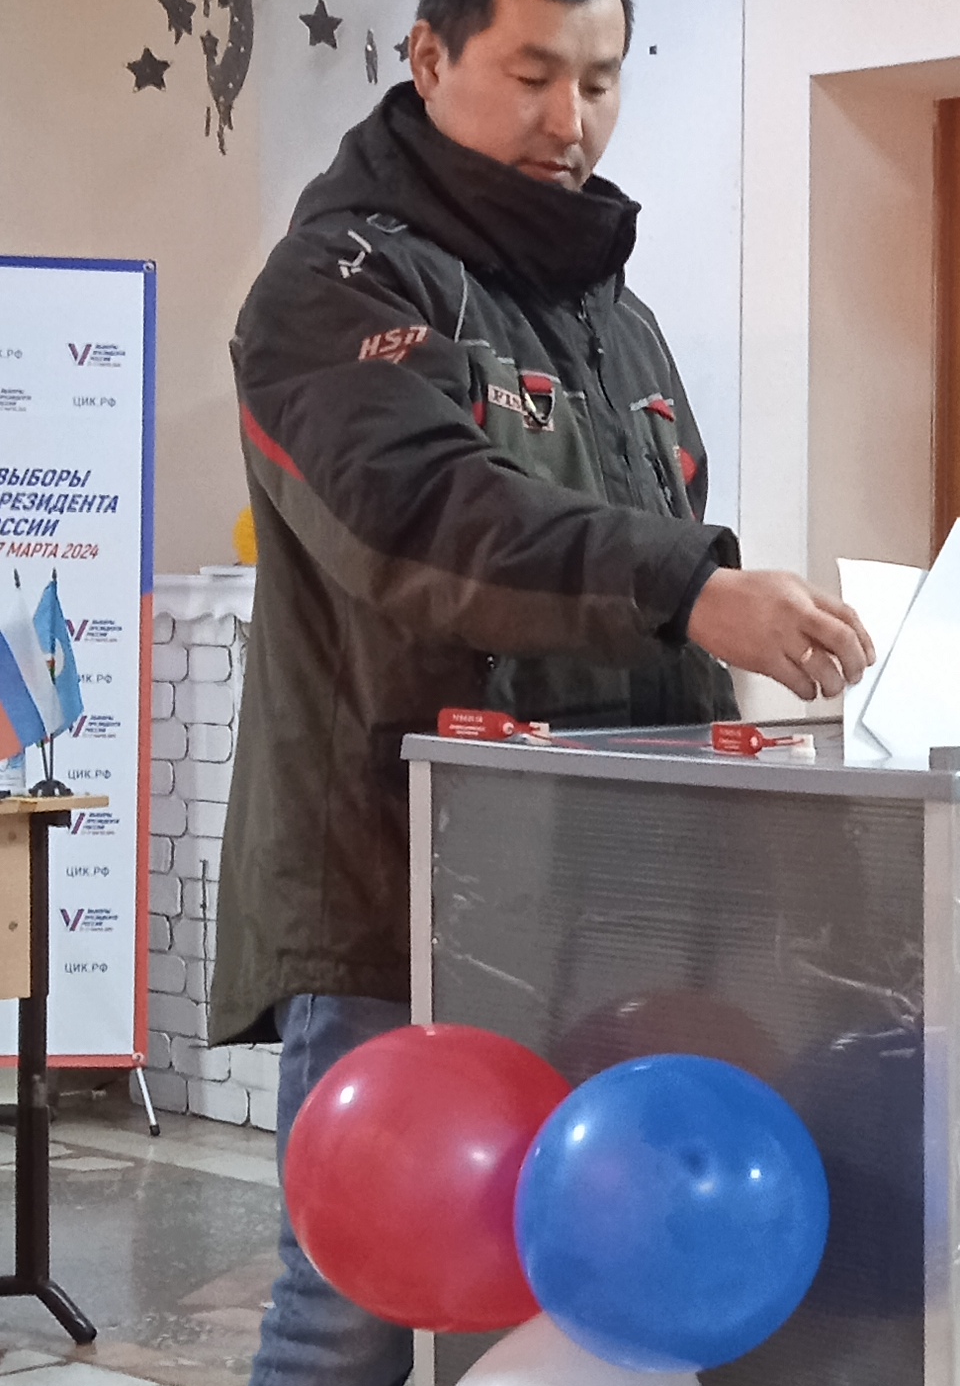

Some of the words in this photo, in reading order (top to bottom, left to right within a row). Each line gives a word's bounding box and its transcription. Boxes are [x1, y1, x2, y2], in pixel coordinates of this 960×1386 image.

[73, 396, 116, 408] ЦИК.РФ
[0, 468, 91, 487] ВЫБОРЫ
[0, 492, 119, 514] РЕЗИДЕНТА
[0, 518, 60, 537] ССИИ
[6, 542, 59, 558] МАРТА
[61, 543, 99, 560] 2024
[68, 769, 112, 780] ЦИК.РФ
[66, 866, 110, 878] ЦИК.РФ
[64, 962, 108, 974] ЦИК.РФ
